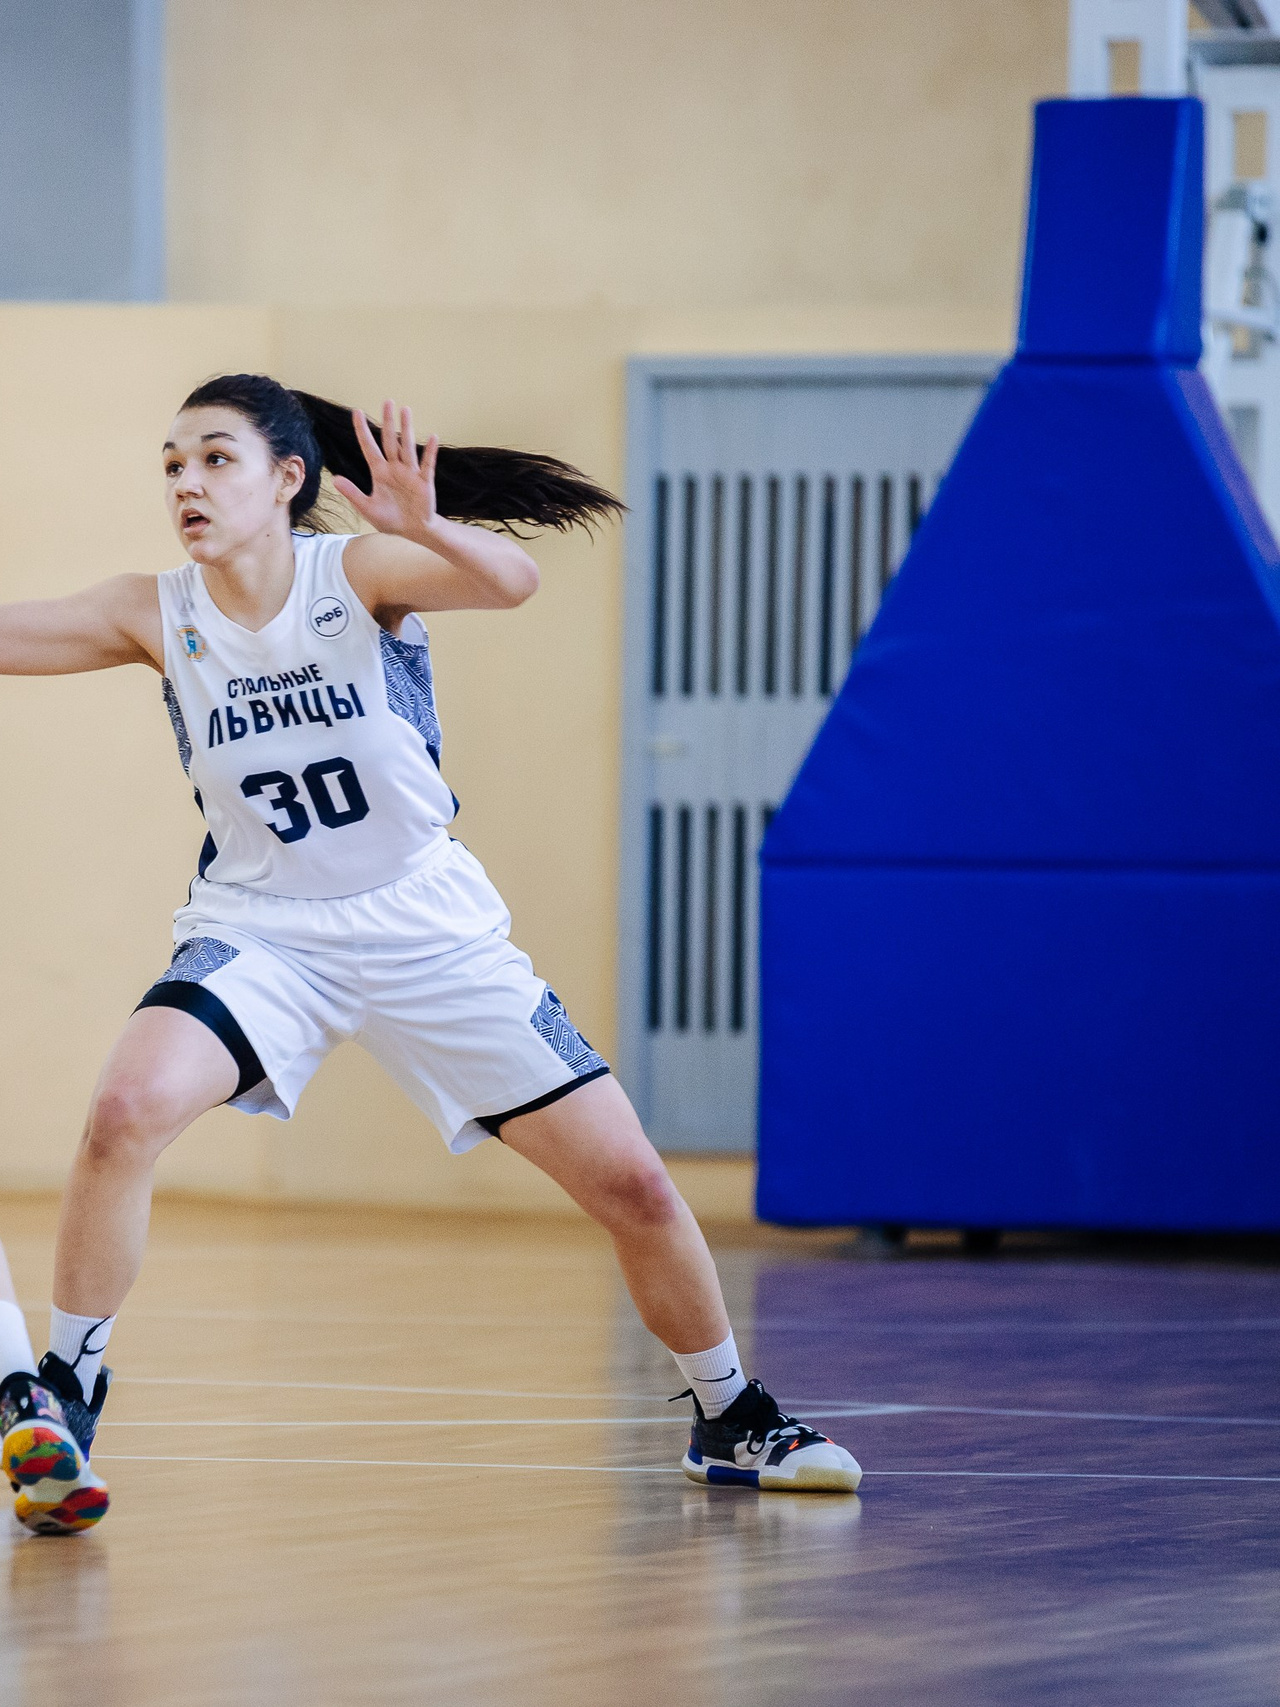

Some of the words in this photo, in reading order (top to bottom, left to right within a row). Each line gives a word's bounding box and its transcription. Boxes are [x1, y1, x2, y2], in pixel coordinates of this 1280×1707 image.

[315, 606, 343, 627] РФБ
[227, 663, 323, 699] СТАЛЬНЫЕ
[208, 683, 366, 748] ЛЬВИЦЫ
[240, 756, 370, 844] 30
